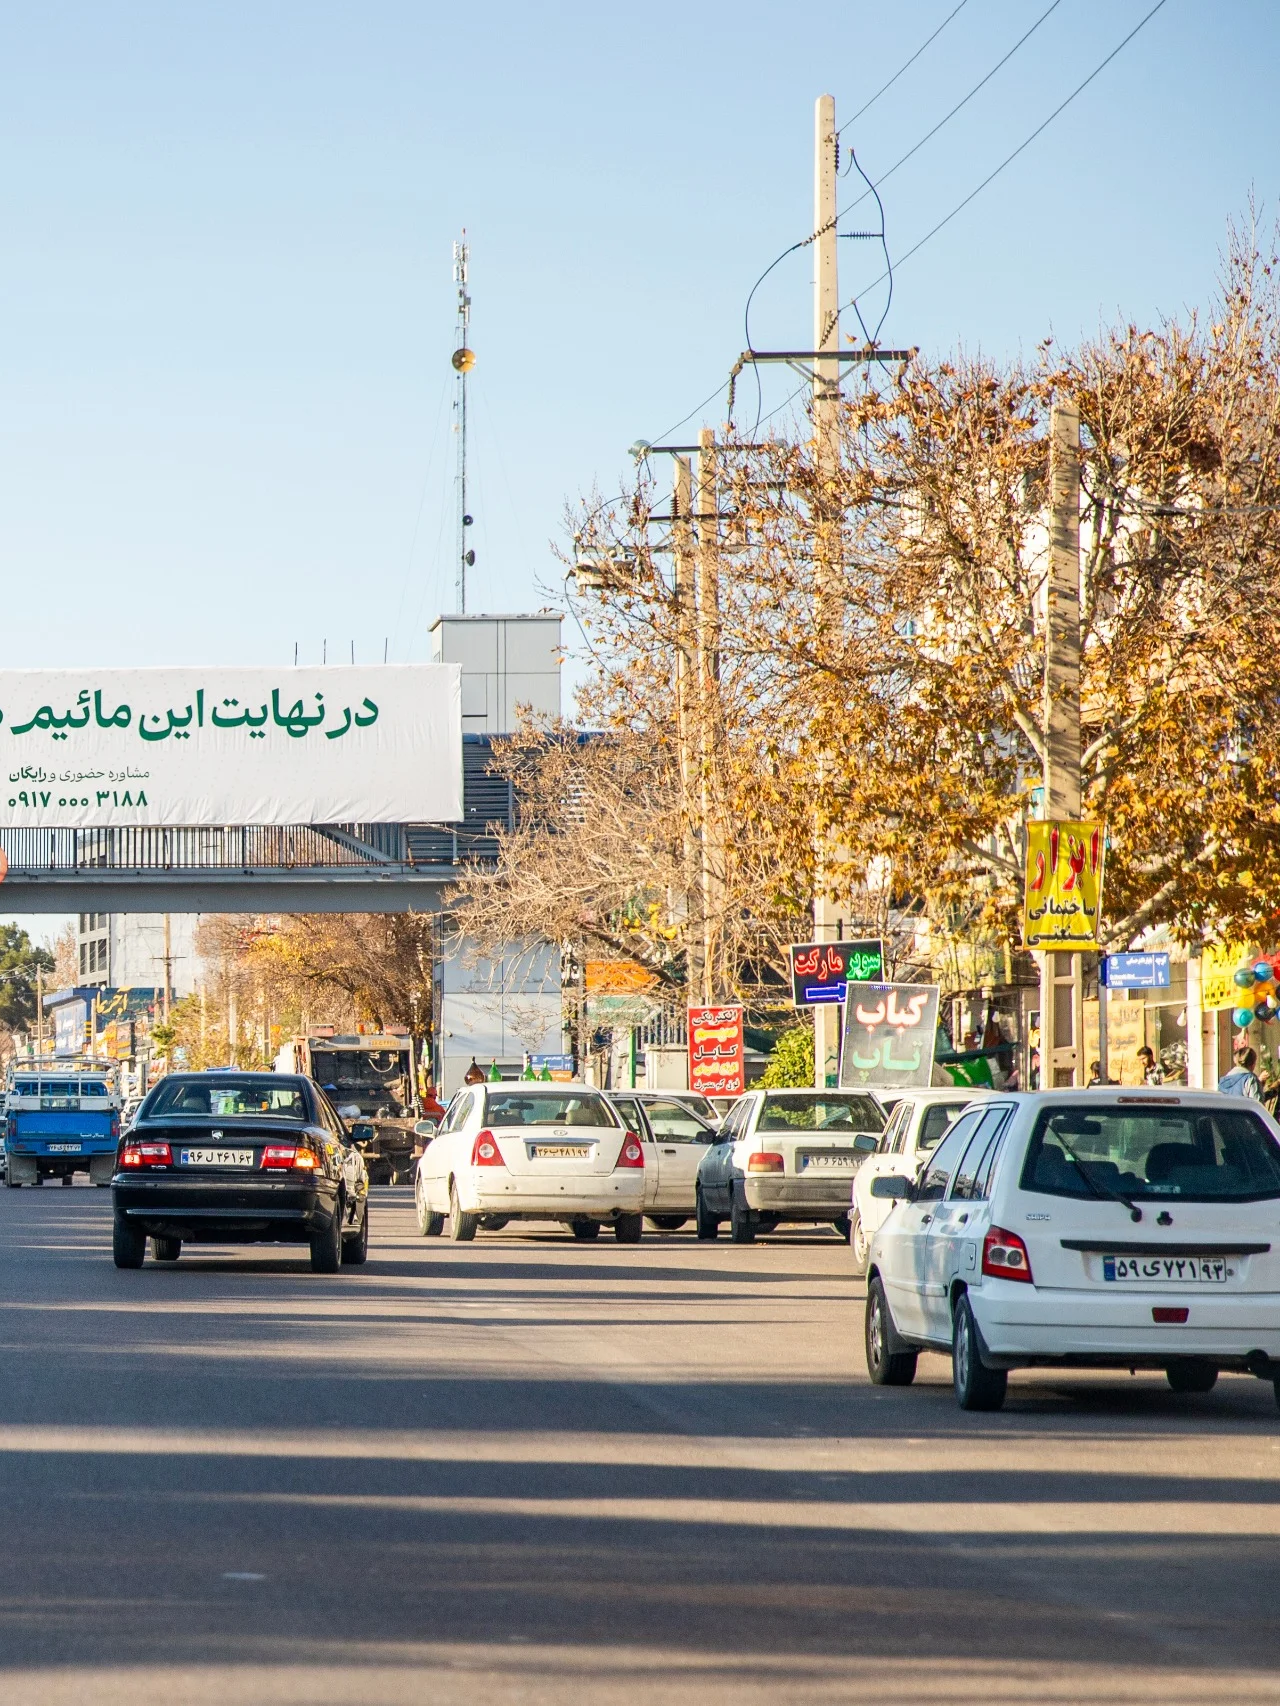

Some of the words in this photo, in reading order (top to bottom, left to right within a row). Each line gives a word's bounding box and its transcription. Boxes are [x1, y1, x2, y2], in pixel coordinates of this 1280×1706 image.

[10, 689, 132, 741] مائیم
[138, 688, 205, 741] این
[211, 688, 326, 739] نهایت
[324, 697, 380, 740] در
[8, 765, 47, 783] رایگان
[47, 772, 56, 783] و
[59, 767, 105, 783] حضوری
[108, 765, 150, 783] مشاوره
[8, 790, 52, 808] ۰۹۱۷
[96, 790, 149, 808] ۳۱۸۸
[1029, 823, 1100, 892] ابزار
[1028, 896, 1096, 921] ساختمانی
[1026, 925, 1095, 946] صنعتی
[794, 946, 844, 980] مارکت
[846, 952, 881, 980] سوپر
[692, 1010, 738, 1026] الکتریکی
[856, 991, 928, 1036] کباب
[693, 1044, 739, 1060] کابل
[852, 1036, 924, 1083] تاپ
